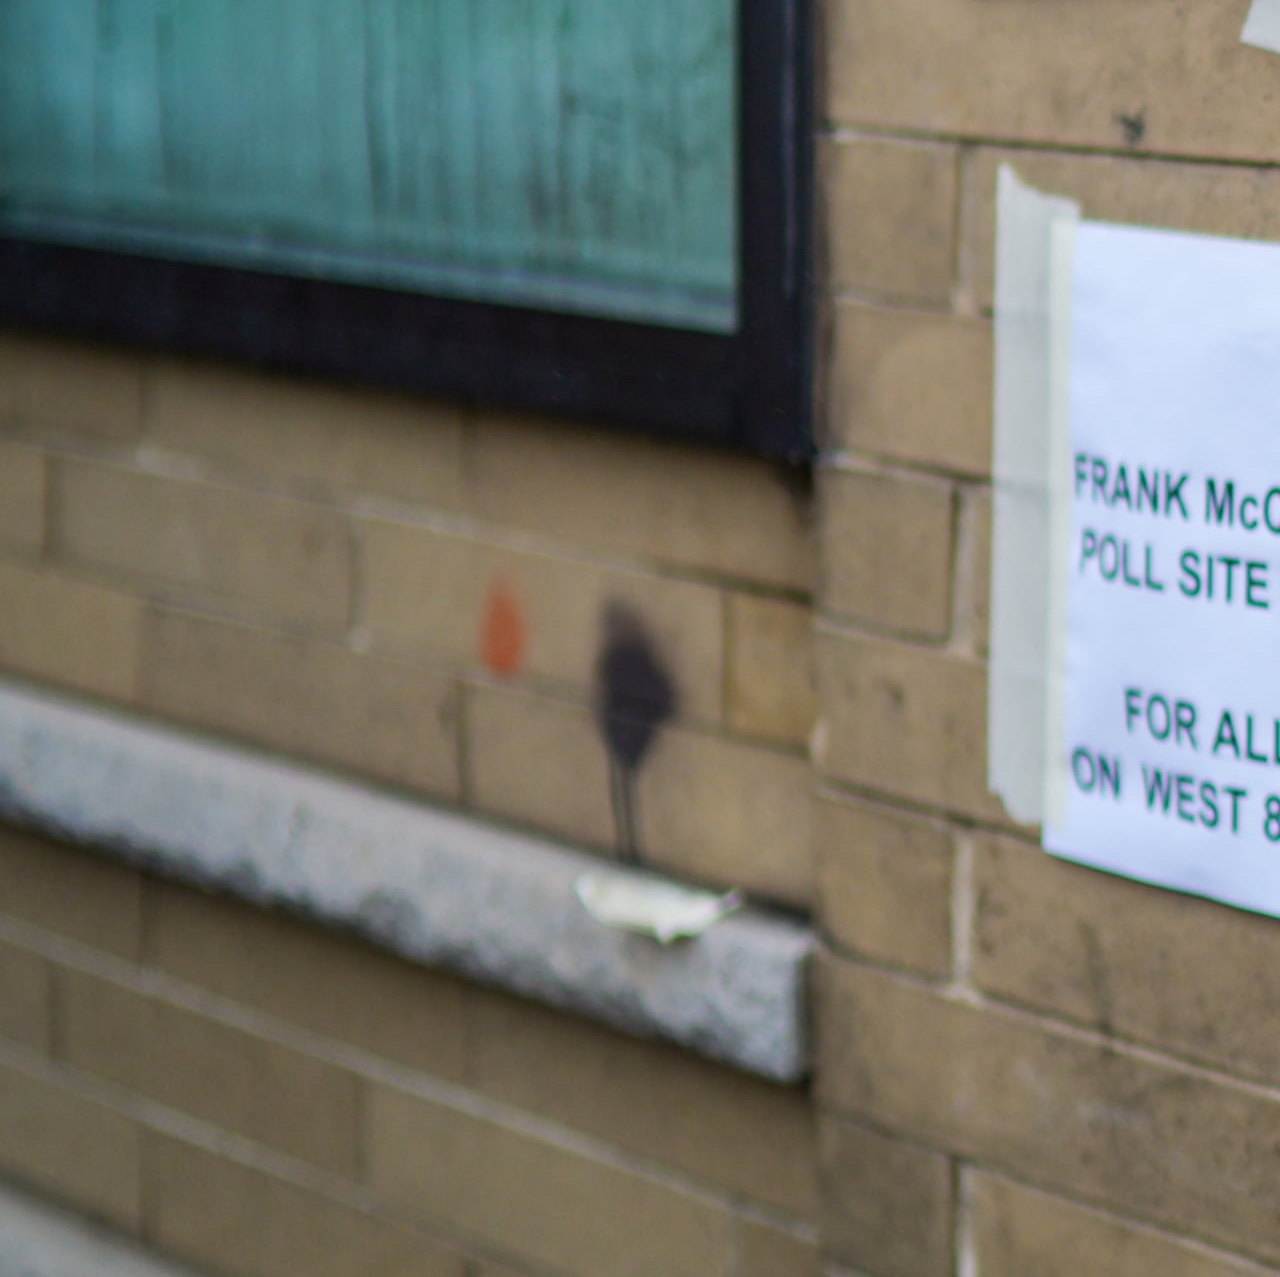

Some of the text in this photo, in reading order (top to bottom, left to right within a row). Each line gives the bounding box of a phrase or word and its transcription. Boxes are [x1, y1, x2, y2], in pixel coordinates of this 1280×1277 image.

[1073, 453, 1190, 521] FRANK
[1079, 528, 1165, 592] POLL
[1178, 549, 1270, 610] SITE
[1122, 687, 1199, 750] FOR
[1070, 747, 1122, 802] ON
[1142, 765, 1248, 835] WEST
